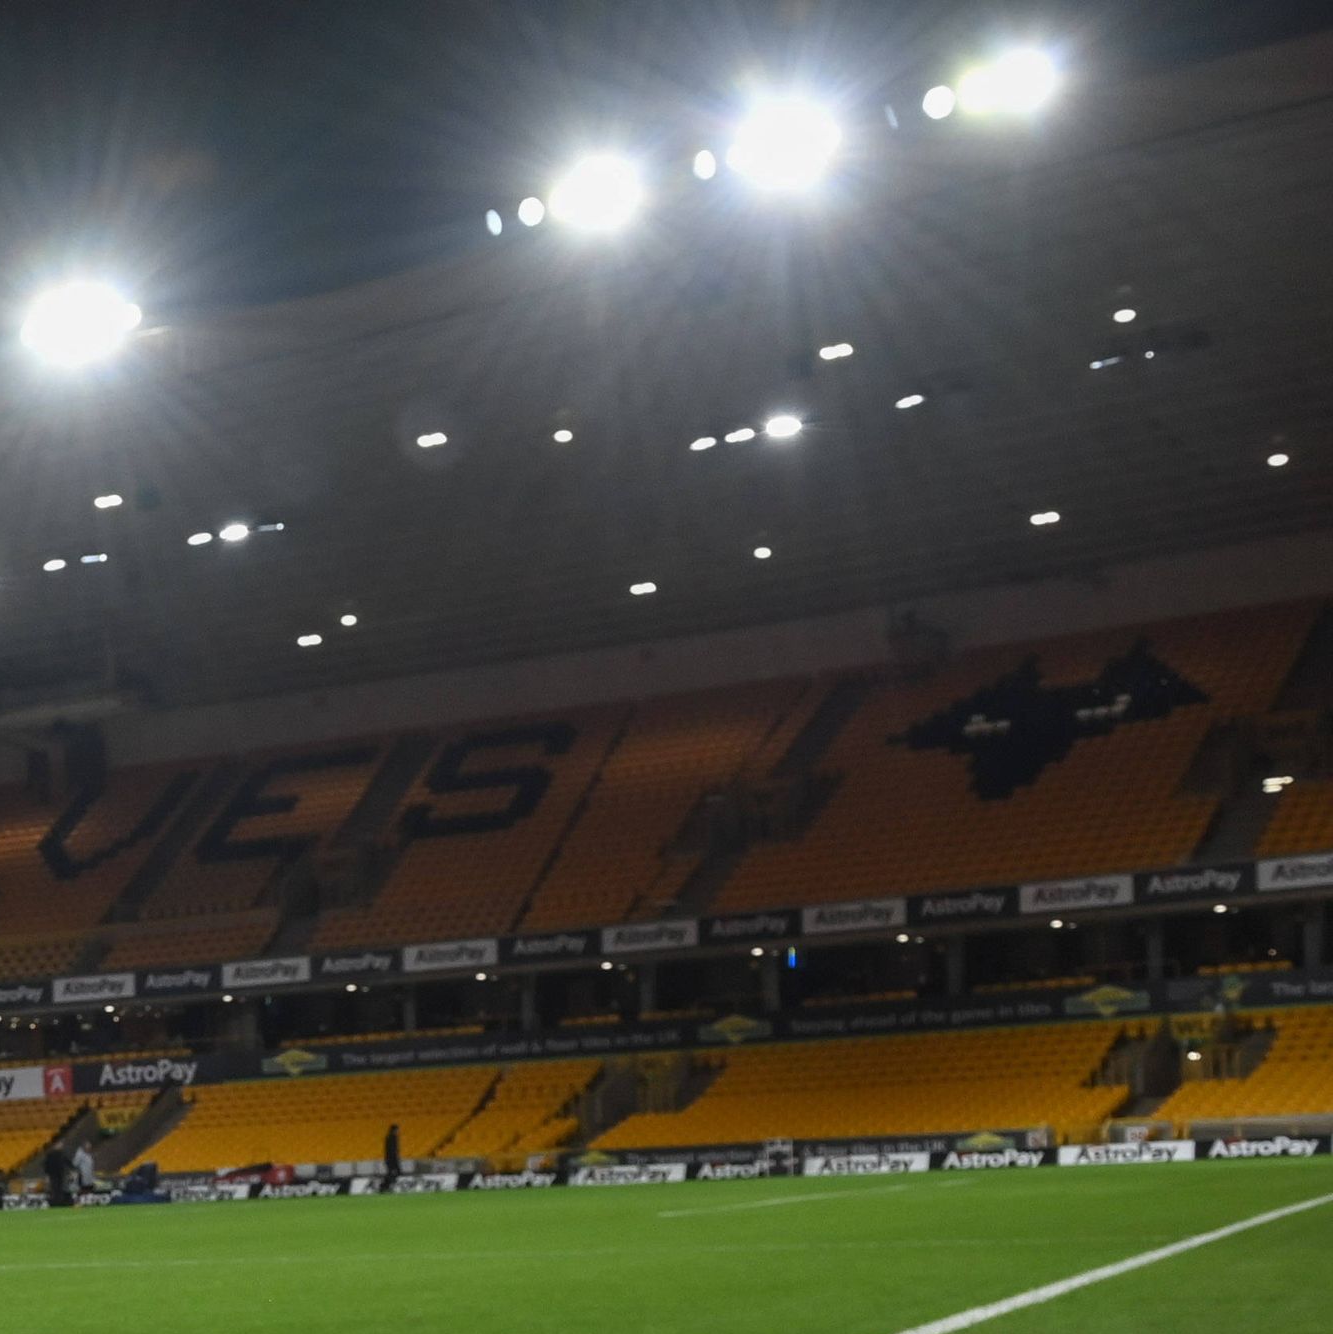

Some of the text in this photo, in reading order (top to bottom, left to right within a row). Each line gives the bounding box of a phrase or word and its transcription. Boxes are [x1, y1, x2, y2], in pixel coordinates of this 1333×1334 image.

[99, 1059, 198, 1086] AstroPay
[1078, 1142, 1179, 1162] AstroPay
[1209, 1135, 1320, 1158] AstroPay
[820, 1153, 915, 1176] AstroPay
[941, 1148, 1045, 1170] AstroPay
[468, 1170, 557, 1190] AstroPay
